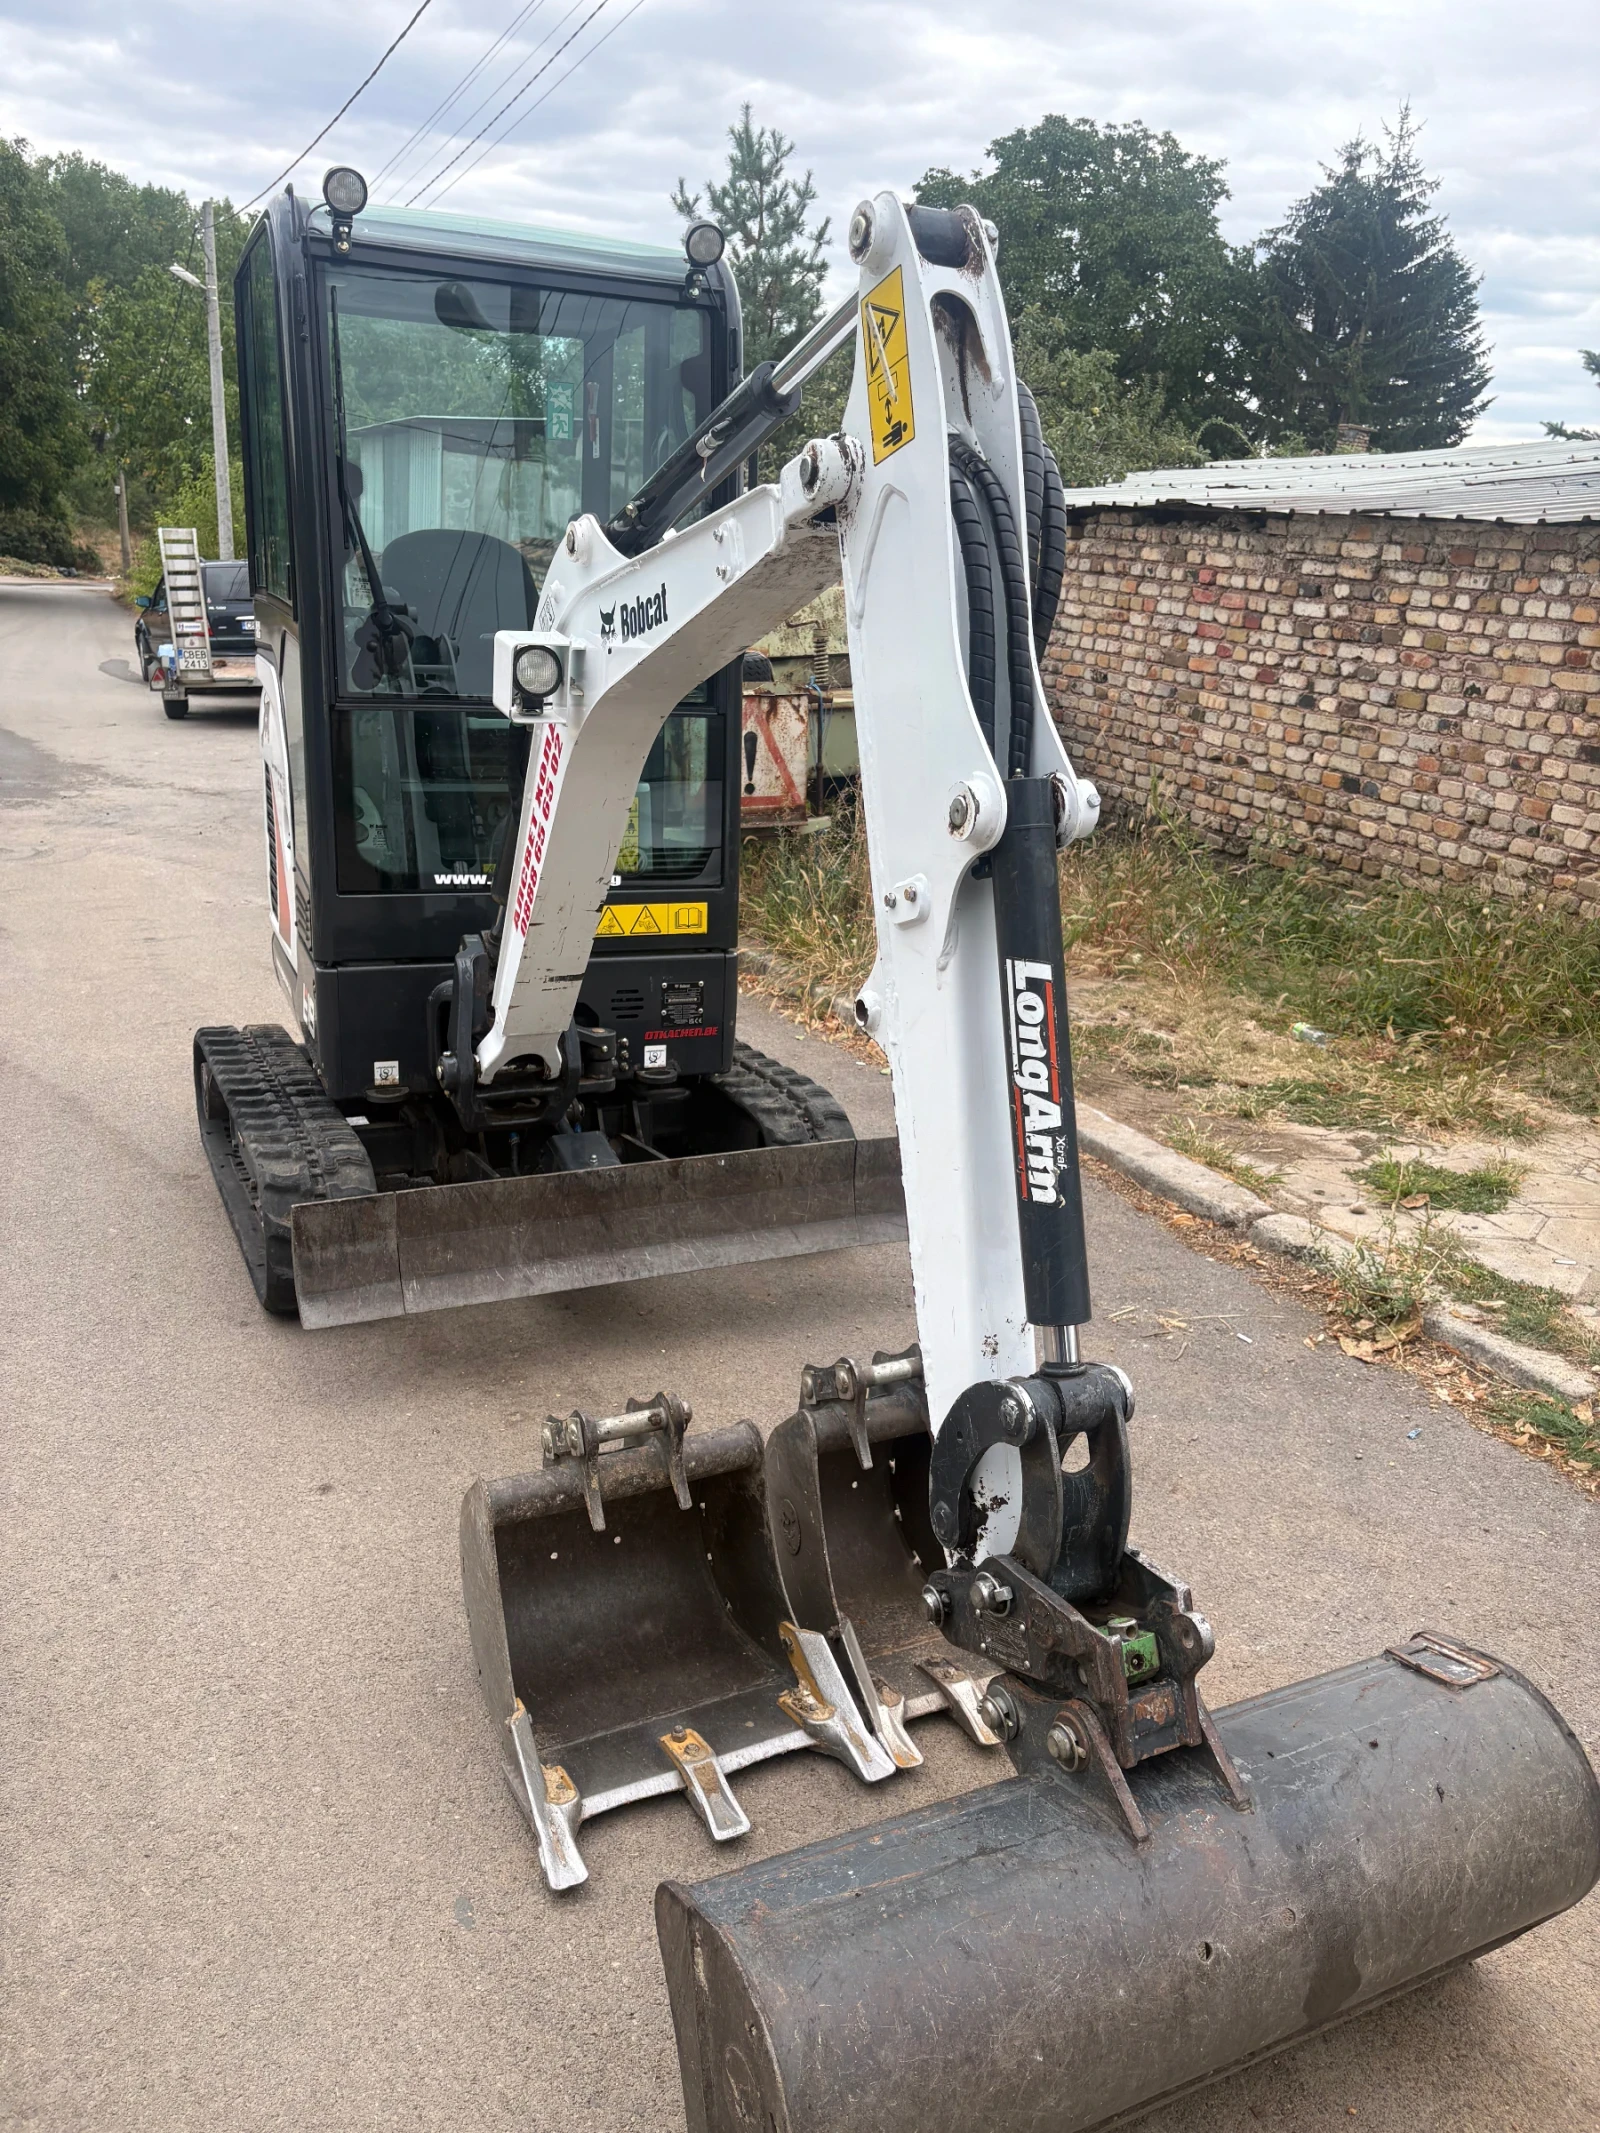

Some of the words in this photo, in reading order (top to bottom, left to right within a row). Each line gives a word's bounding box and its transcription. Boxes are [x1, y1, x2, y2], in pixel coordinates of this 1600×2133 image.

[620, 583, 668, 644] Bobcat
[183, 650, 207, 660] CBEB
[184, 660, 208, 669] 2413
[521, 865, 538, 938] 0888
[534, 822, 546, 865] 65
[542, 777, 554, 822] 65
[551, 732, 563, 776] 02
[1012, 959, 1063, 1205] LongArm
